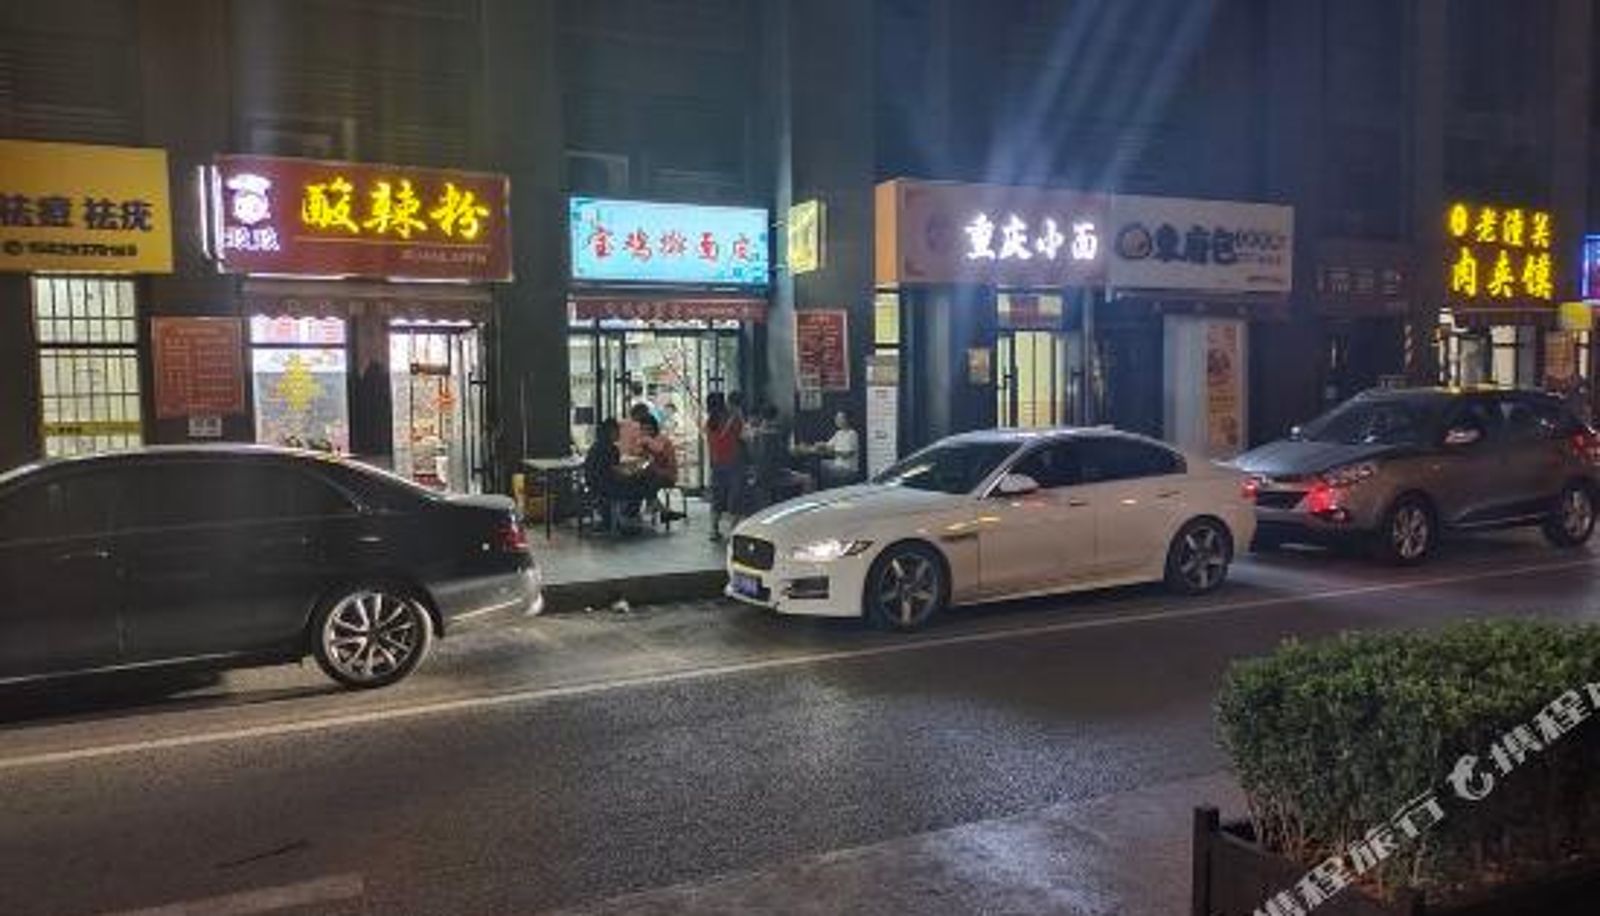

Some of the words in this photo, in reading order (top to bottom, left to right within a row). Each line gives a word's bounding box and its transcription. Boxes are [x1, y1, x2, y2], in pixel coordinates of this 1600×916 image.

[301, 177, 490, 241] 酸辣粉
[586, 225, 756, 262] 宝鸡擀面皮
[964, 212, 1099, 262] 重庆小面
[1451, 246, 1554, 301] 肉夹馍
